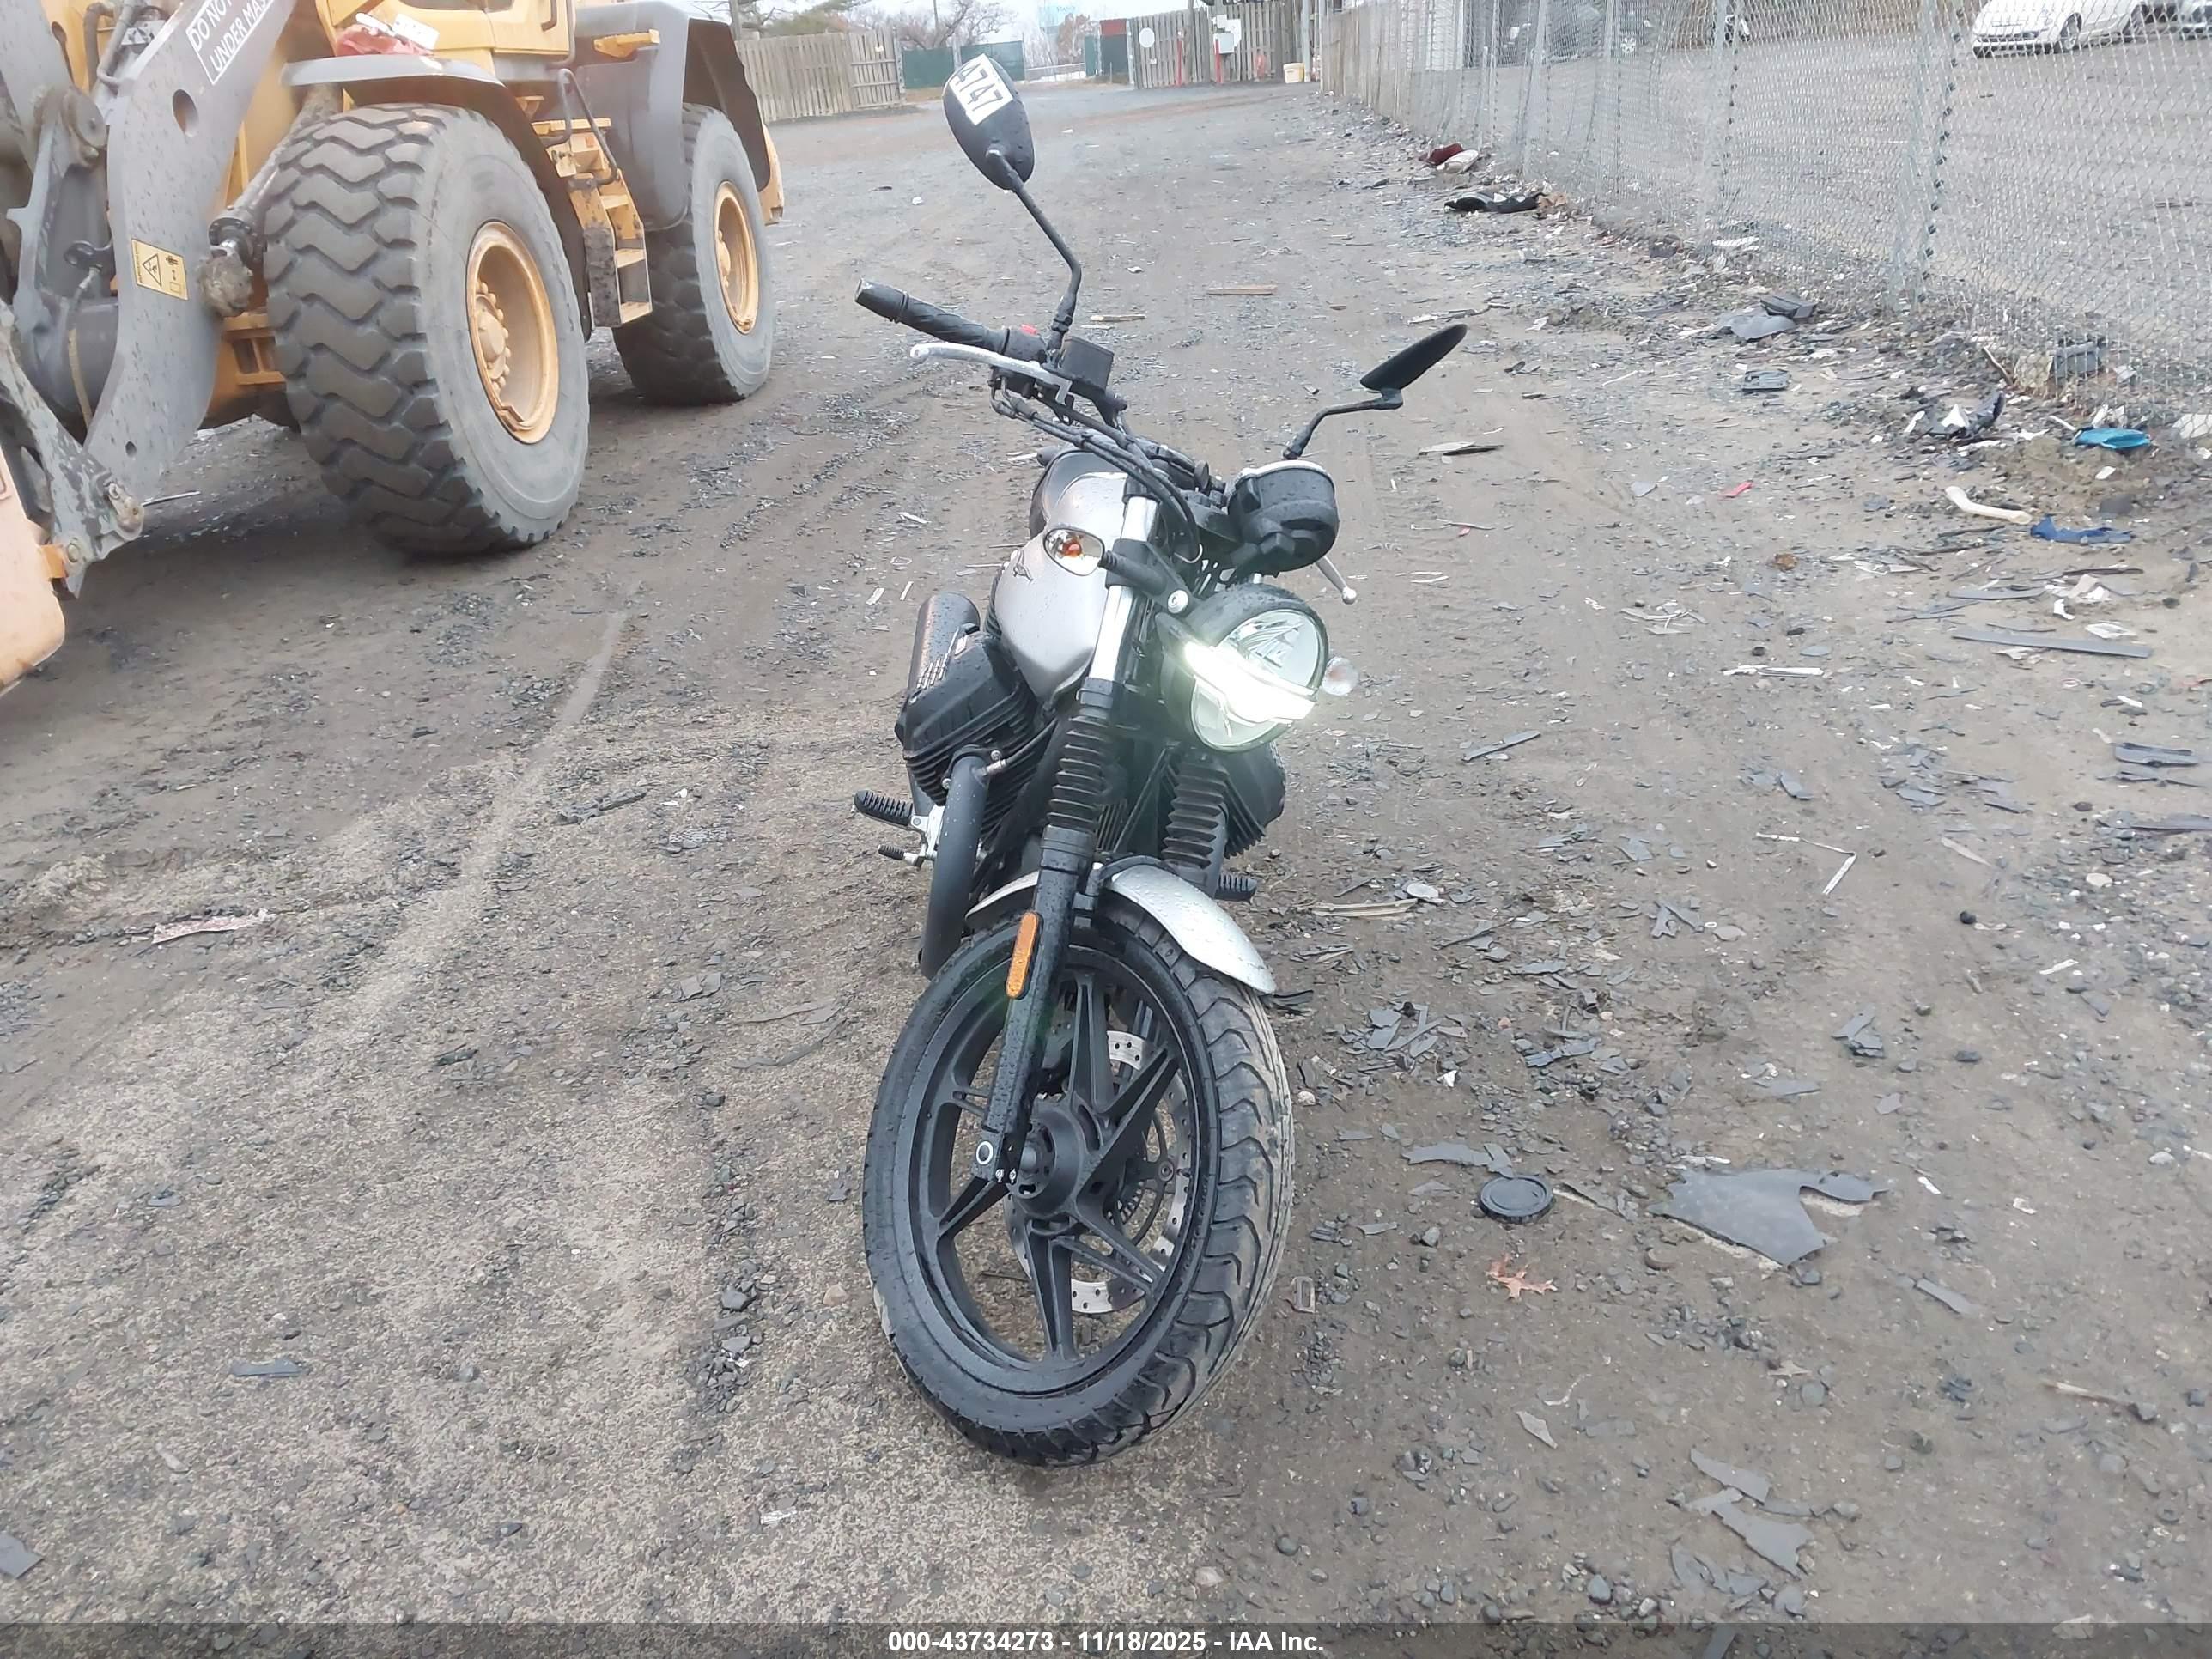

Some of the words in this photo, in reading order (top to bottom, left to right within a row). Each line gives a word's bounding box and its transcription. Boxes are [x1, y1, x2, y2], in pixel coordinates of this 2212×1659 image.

[191, 17, 210, 52] DO
[210, 17, 248, 72] UNDER
[956, 63, 1003, 111] 4747
